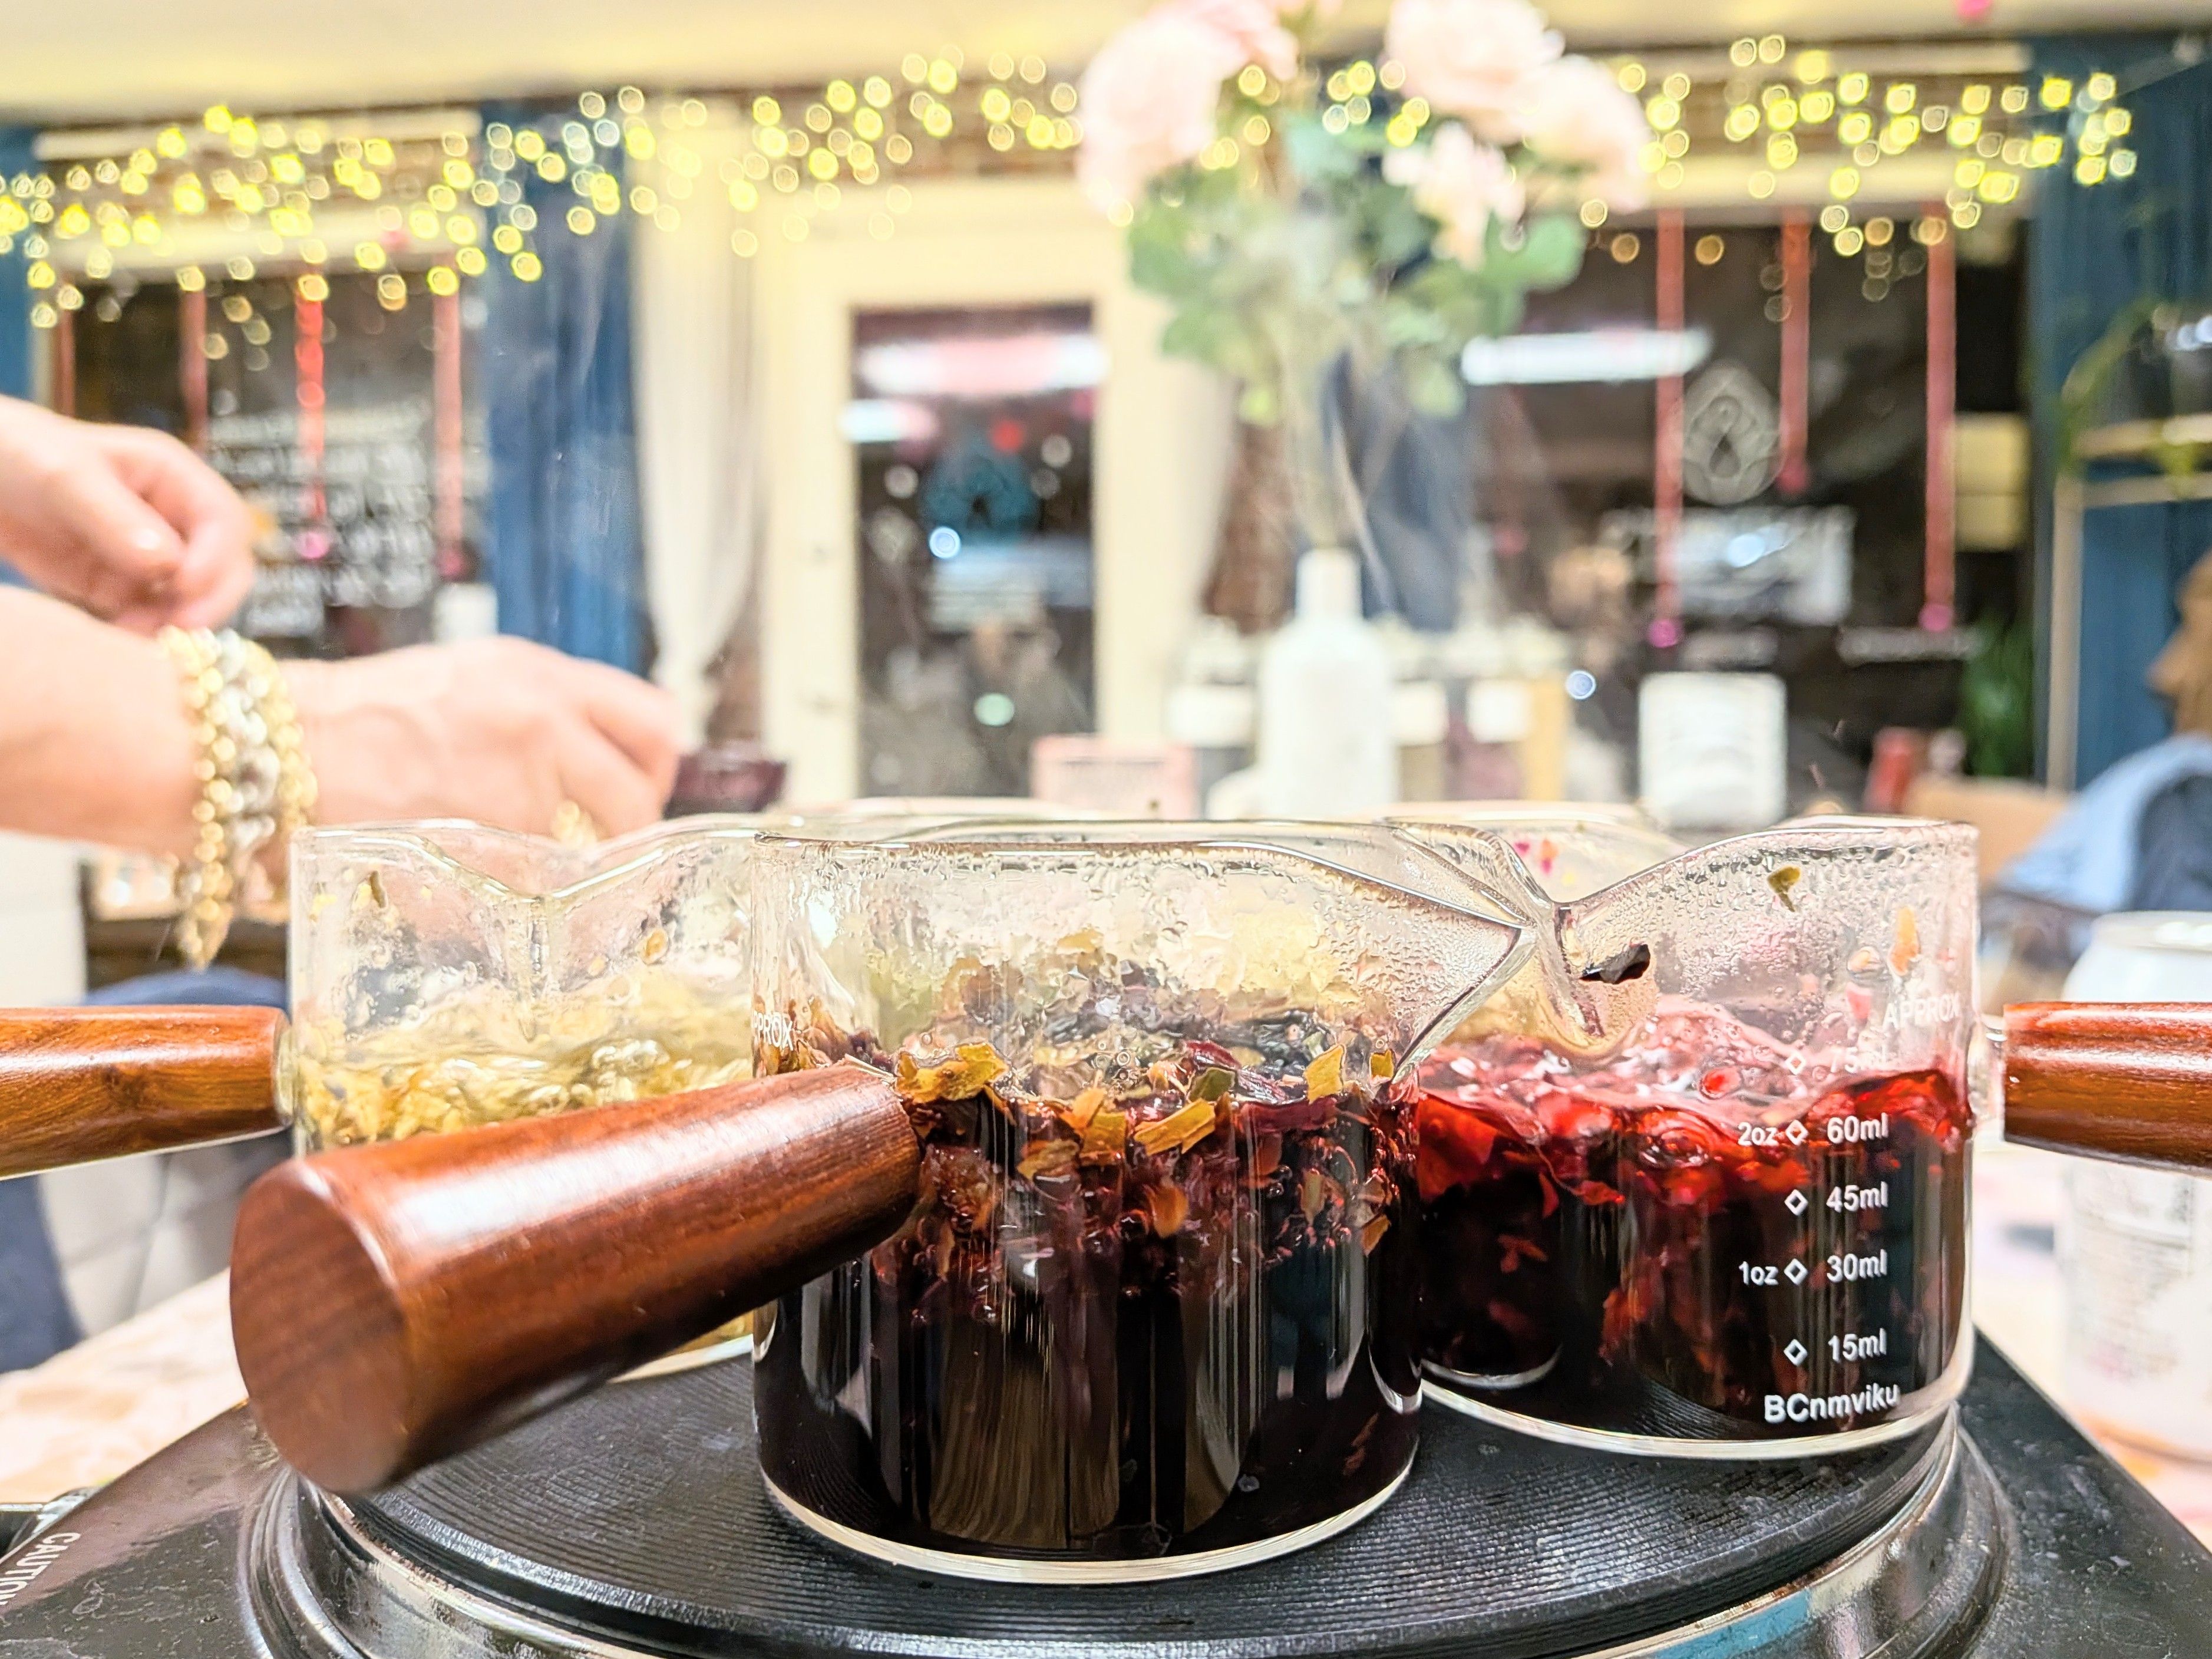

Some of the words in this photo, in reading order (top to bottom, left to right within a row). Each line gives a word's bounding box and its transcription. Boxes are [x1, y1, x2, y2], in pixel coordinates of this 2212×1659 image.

[753, 1011, 794, 1051] PPROX
[1738, 1122, 1778, 1146] 2oz
[1827, 1113, 1889, 1145] 60ml
[1827, 1182, 1888, 1212] 45ml
[1739, 1261, 1778, 1285] 1oz
[1827, 1249, 1887, 1282] 30ml
[1828, 1328, 1887, 1362] 15ml
[1764, 1383, 1900, 1423] BCnmviku
